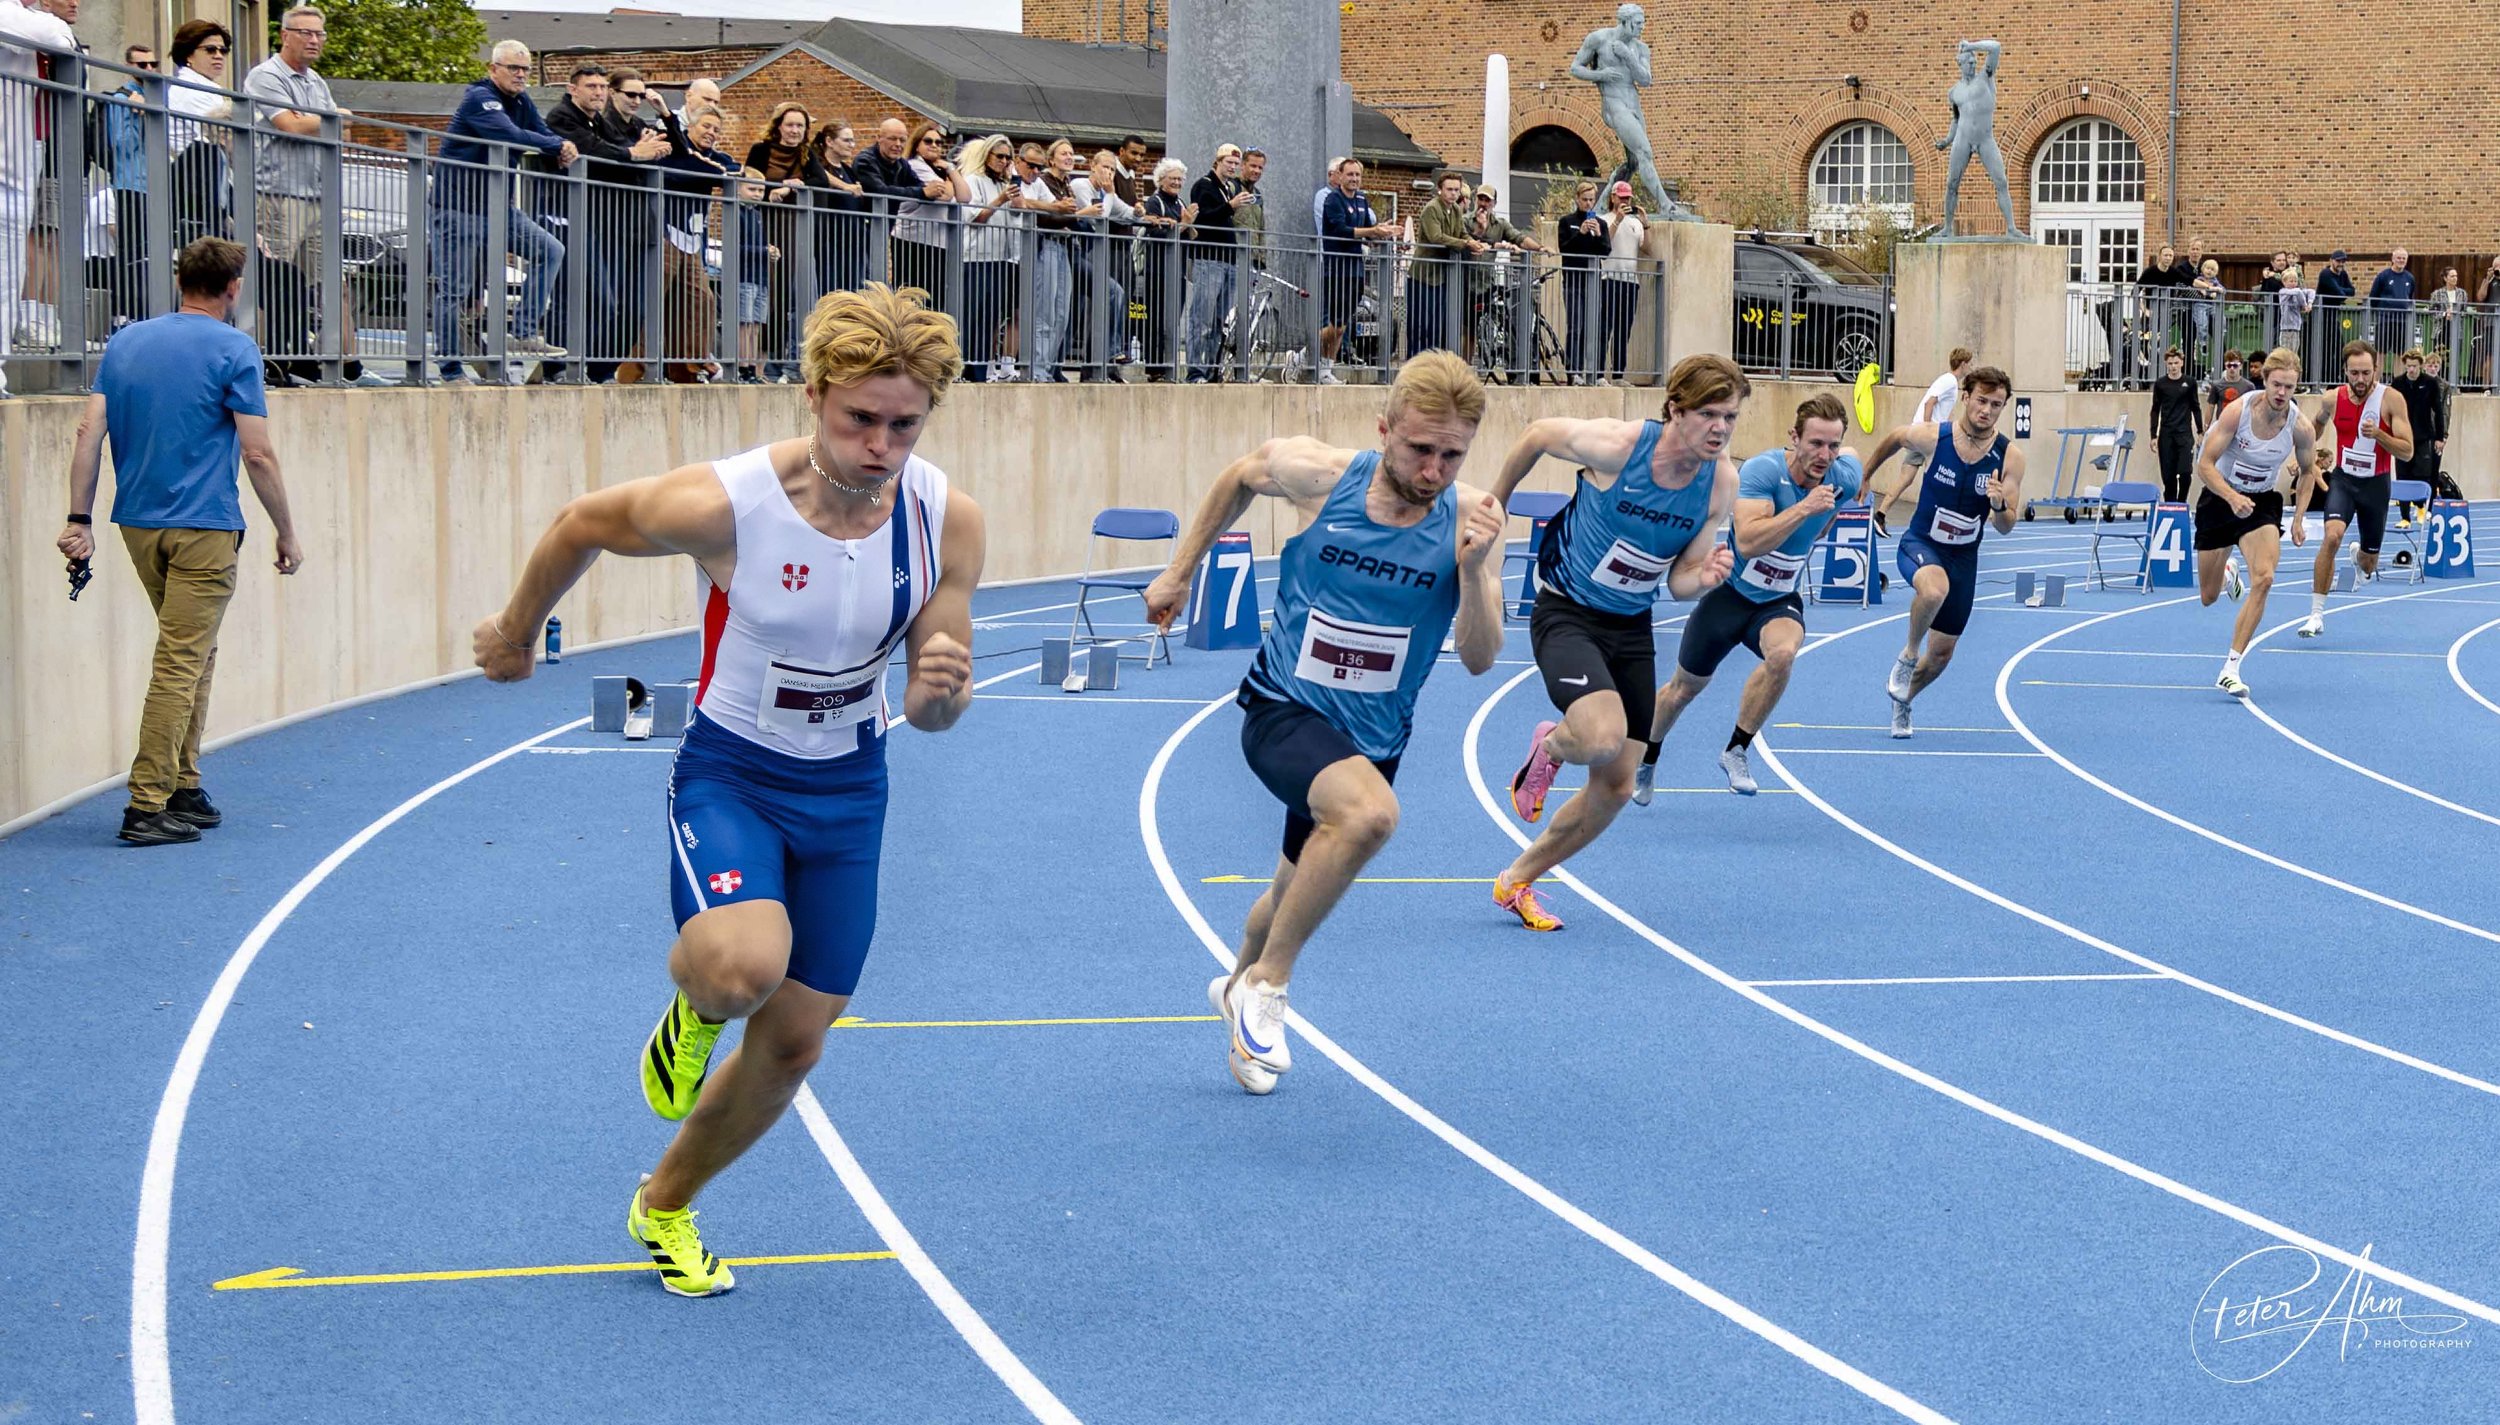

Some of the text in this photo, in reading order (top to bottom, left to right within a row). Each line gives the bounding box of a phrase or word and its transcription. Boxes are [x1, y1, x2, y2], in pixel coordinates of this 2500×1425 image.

[1933, 472, 1956, 488] Atletik
[1938, 464, 1956, 479] Holte
[1616, 500, 1695, 531] SPARTA
[1832, 527, 1868, 588] 5
[2149, 517, 2186, 572] 4
[1318, 544, 1437, 590] SPARTA
[1217, 552, 1251, 630] 7
[1338, 652, 1365, 667] 136
[811, 694, 845, 709] 209
